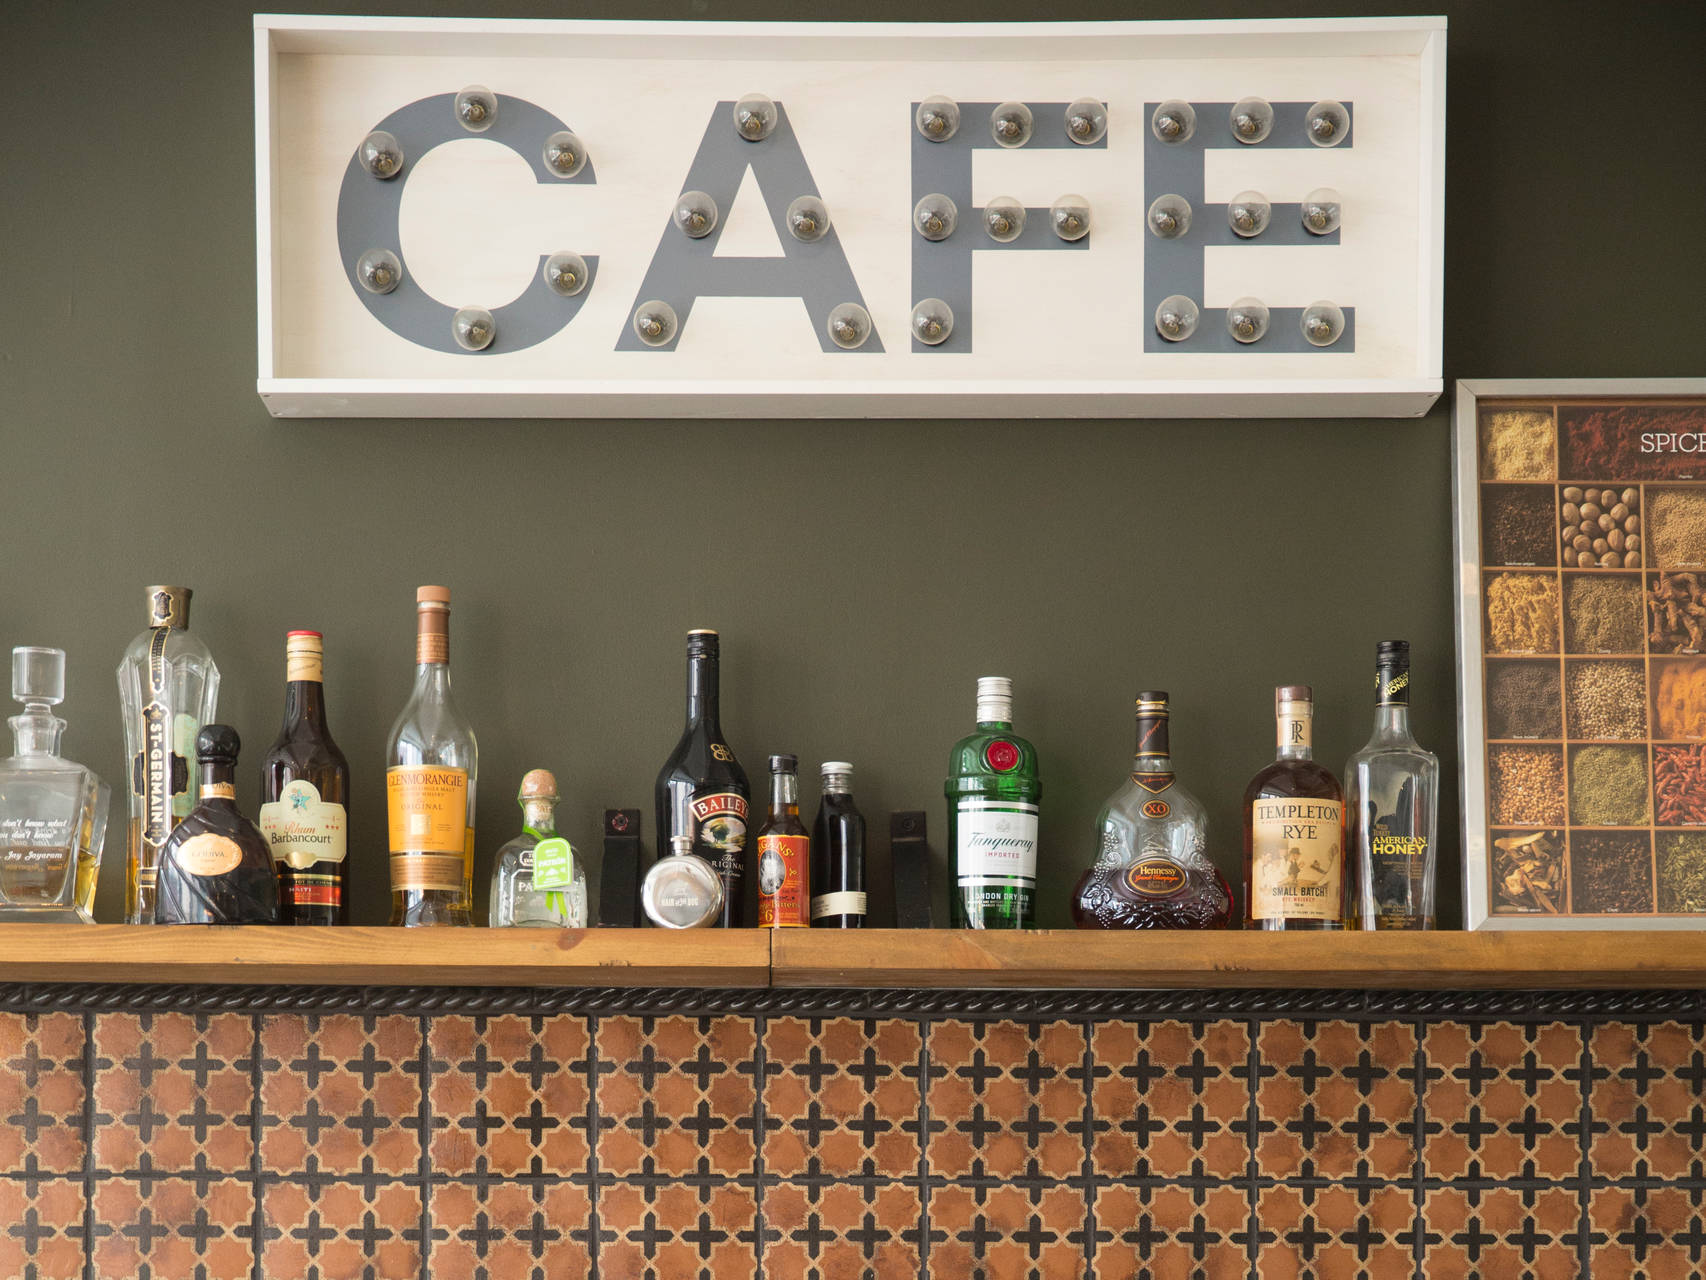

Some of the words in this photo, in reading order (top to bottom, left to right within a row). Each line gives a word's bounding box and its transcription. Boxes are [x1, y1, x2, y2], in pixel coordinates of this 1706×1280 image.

[337, 91, 1356, 357] CAFE
[150, 722, 163, 823] ST-GERMAIN
[388, 773, 464, 787] GLENMORANGIE
[401, 803, 444, 811] ORIGINAL
[1257, 804, 1339, 821] TEMPLETON
[25, 819, 46, 827] know
[48, 819, 68, 827] what
[283, 821, 316, 834] Rhum
[271, 831, 333, 844] Barbancourt
[1282, 824, 1318, 840] RYE
[967, 832, 1034, 852] Tanqueray
[1373, 836, 1427, 845] AMERICAN
[4, 850, 22, 860] Jay
[24, 850, 63, 860] Jayaram
[985, 851, 1021, 859] IMPORTED
[1372, 844, 1426, 855] HONEY
[711, 860, 745, 871] RIGINAL
[1140, 866, 1177, 876] Hennessy
[1003, 893, 1018, 901] DRY
[1020, 893, 1030, 901] GIN
[1272, 887, 1298, 897] SMALL
[1301, 887, 1325, 897] BATCH
[764, 909, 774, 922] 6
